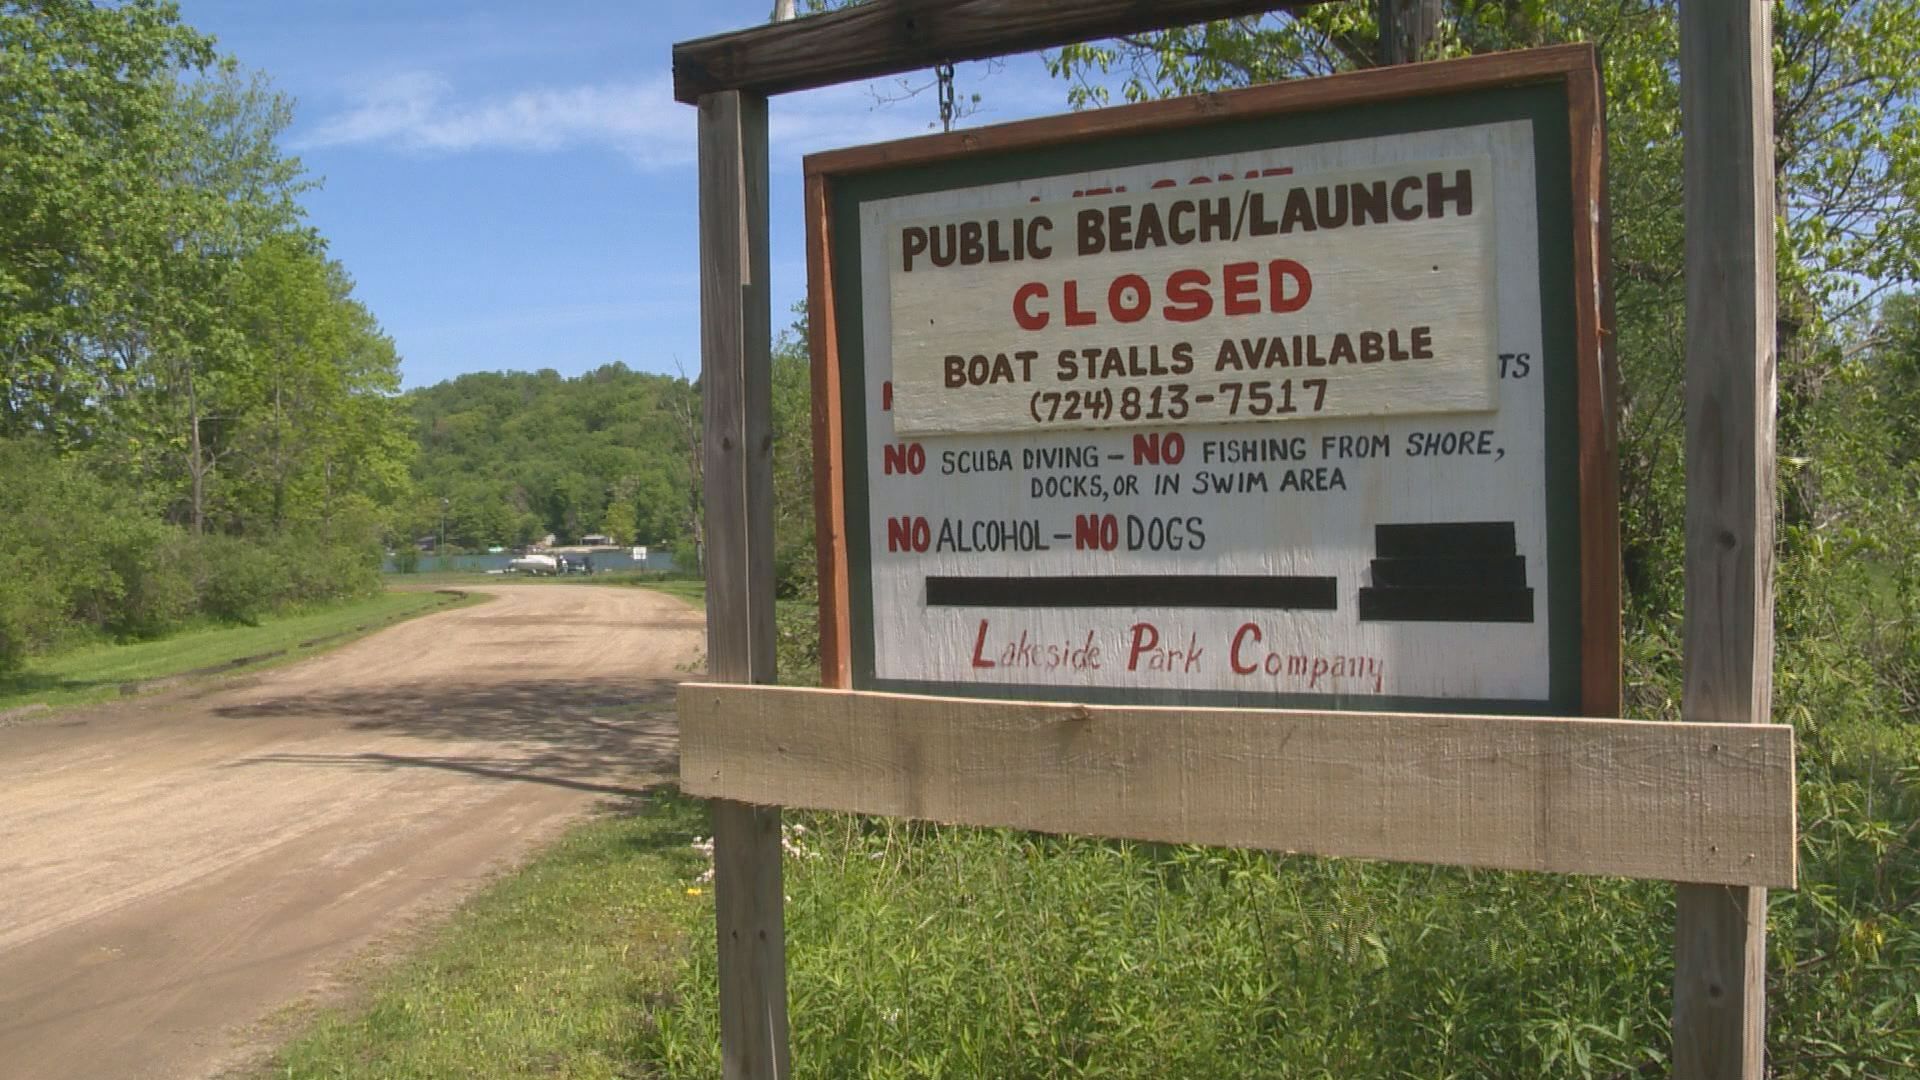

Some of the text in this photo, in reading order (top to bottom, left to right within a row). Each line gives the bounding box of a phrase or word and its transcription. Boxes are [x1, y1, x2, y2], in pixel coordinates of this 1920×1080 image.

[902, 215, 1054, 272] PUBLIC
[1077, 168, 1473, 256] BEACH/LAUNCH
[1013, 259, 1312, 331] CLOSED
[944, 326, 1433, 388] BOAT STALLS AVAILABLE
[884, 443, 926, 475] NO
[942, 450, 1013, 475] SCUBA
[1023, 446, 1099, 470] DIVING
[1133, 432, 1185, 466] NO
[1203, 437, 1307, 463] FISHING
[1322, 435, 1390, 460] FROM
[1406, 430, 1505, 462] SHORE,
[1154, 473, 1180, 495] IN
[1192, 471, 1268, 494] SWIM
[1279, 467, 1347, 492] AREA
[887, 516, 931, 553] NO
[936, 518, 1050, 552] ALCOHOL
[1075, 514, 1119, 551] NO
[1126, 517, 1206, 550] DOGS
[971, 618, 1384, 693] Lakeside Park Company
